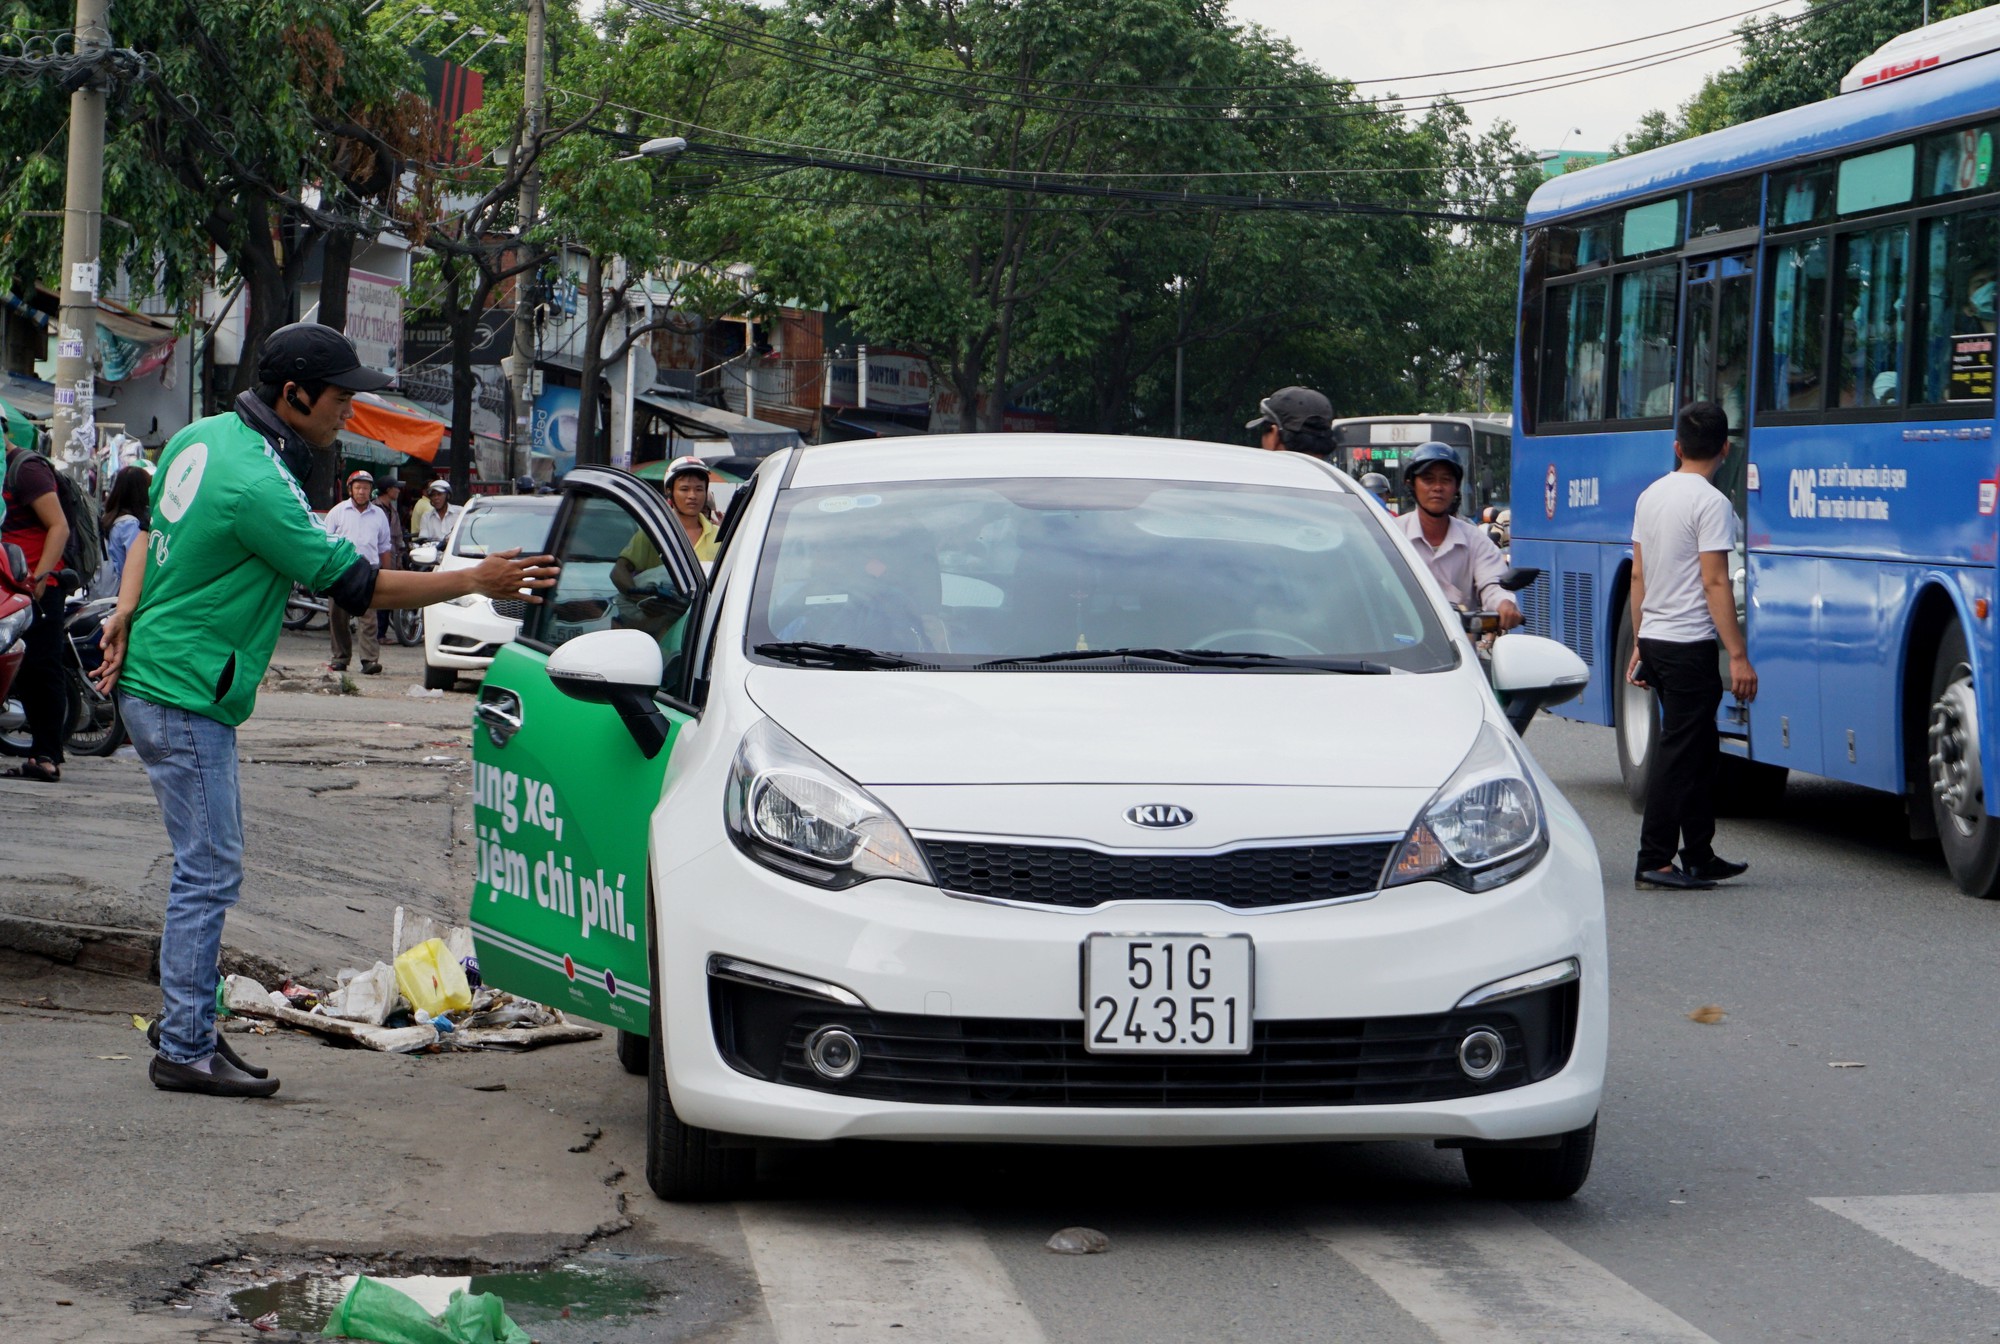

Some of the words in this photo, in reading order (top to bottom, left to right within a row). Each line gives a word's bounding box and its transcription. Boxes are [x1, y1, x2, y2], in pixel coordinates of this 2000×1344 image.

[533, 409, 547, 447] pepsi
[1391, 427, 1407, 441] 91
[1789, 468, 1817, 518] CNG
[523, 777, 563, 841] xe,
[1134, 805, 1187, 823] KIA
[534, 850, 575, 918] chi
[579, 868, 635, 942] phí.
[1128, 942, 1212, 991] 51G
[1094, 996, 1236, 1045] 243.51
